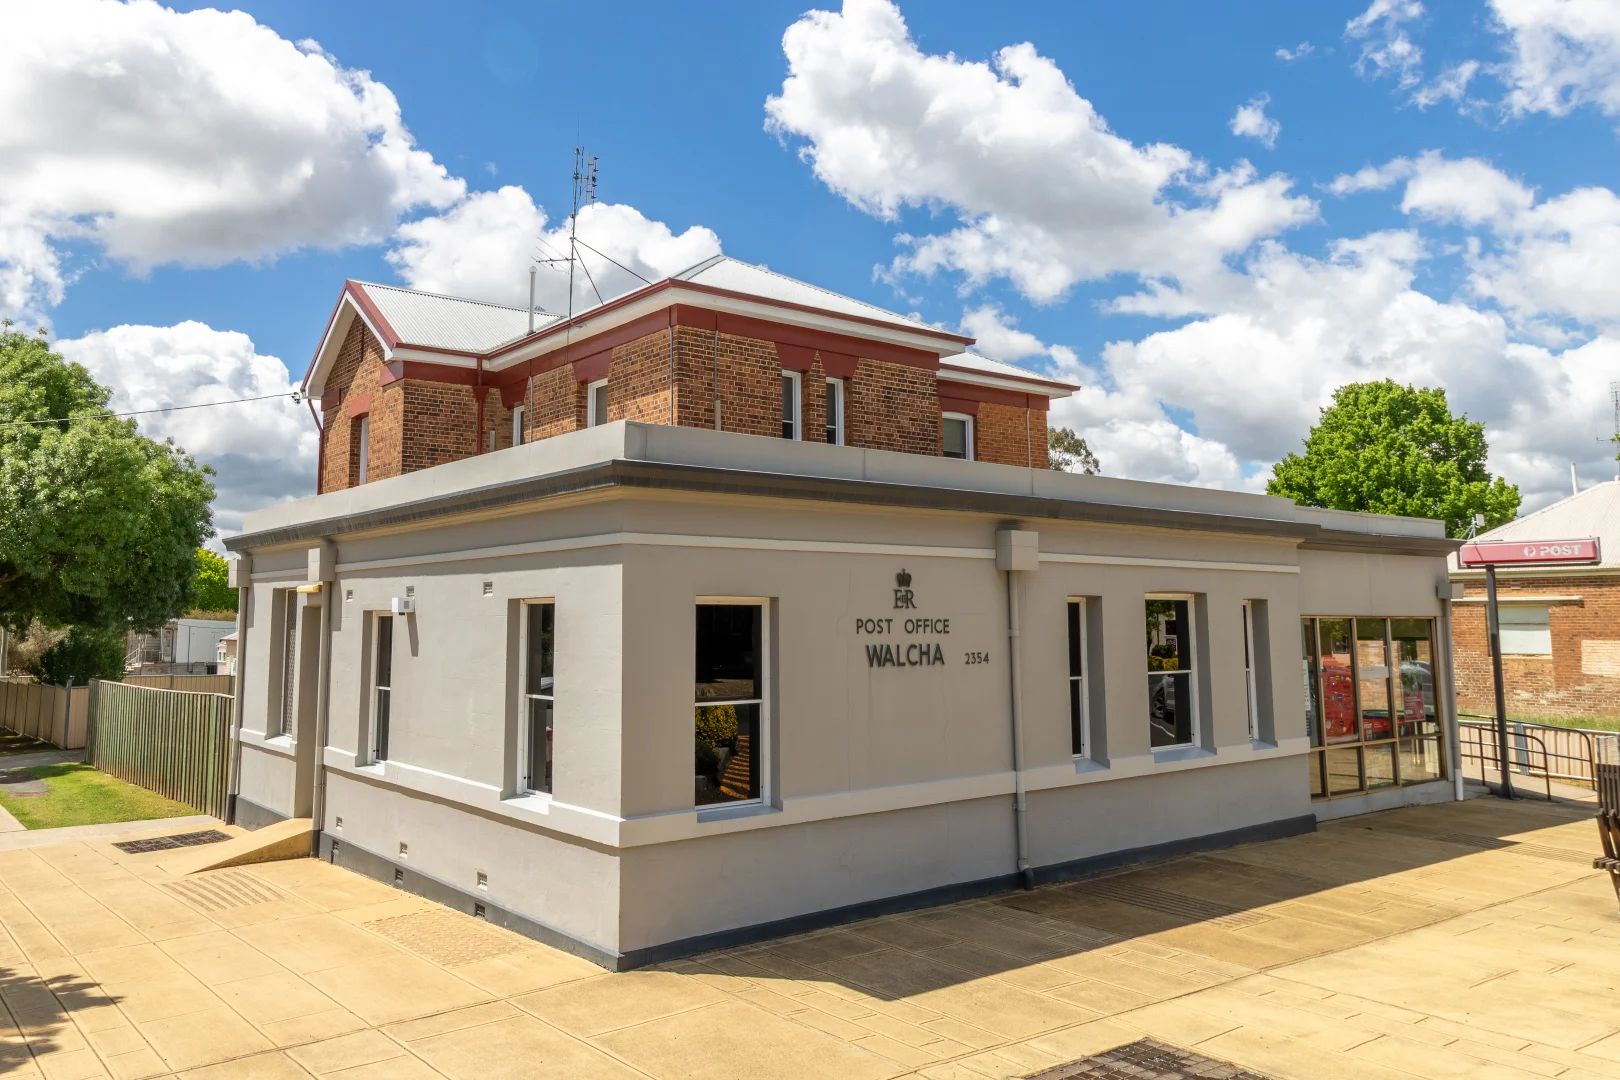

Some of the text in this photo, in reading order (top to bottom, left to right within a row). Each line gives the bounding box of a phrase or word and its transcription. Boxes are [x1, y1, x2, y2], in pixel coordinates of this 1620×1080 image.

[1540, 545, 1582, 556] POST
[856, 618, 950, 634] POST OFFICE
[865, 643, 989, 667] WALCHA 2354
